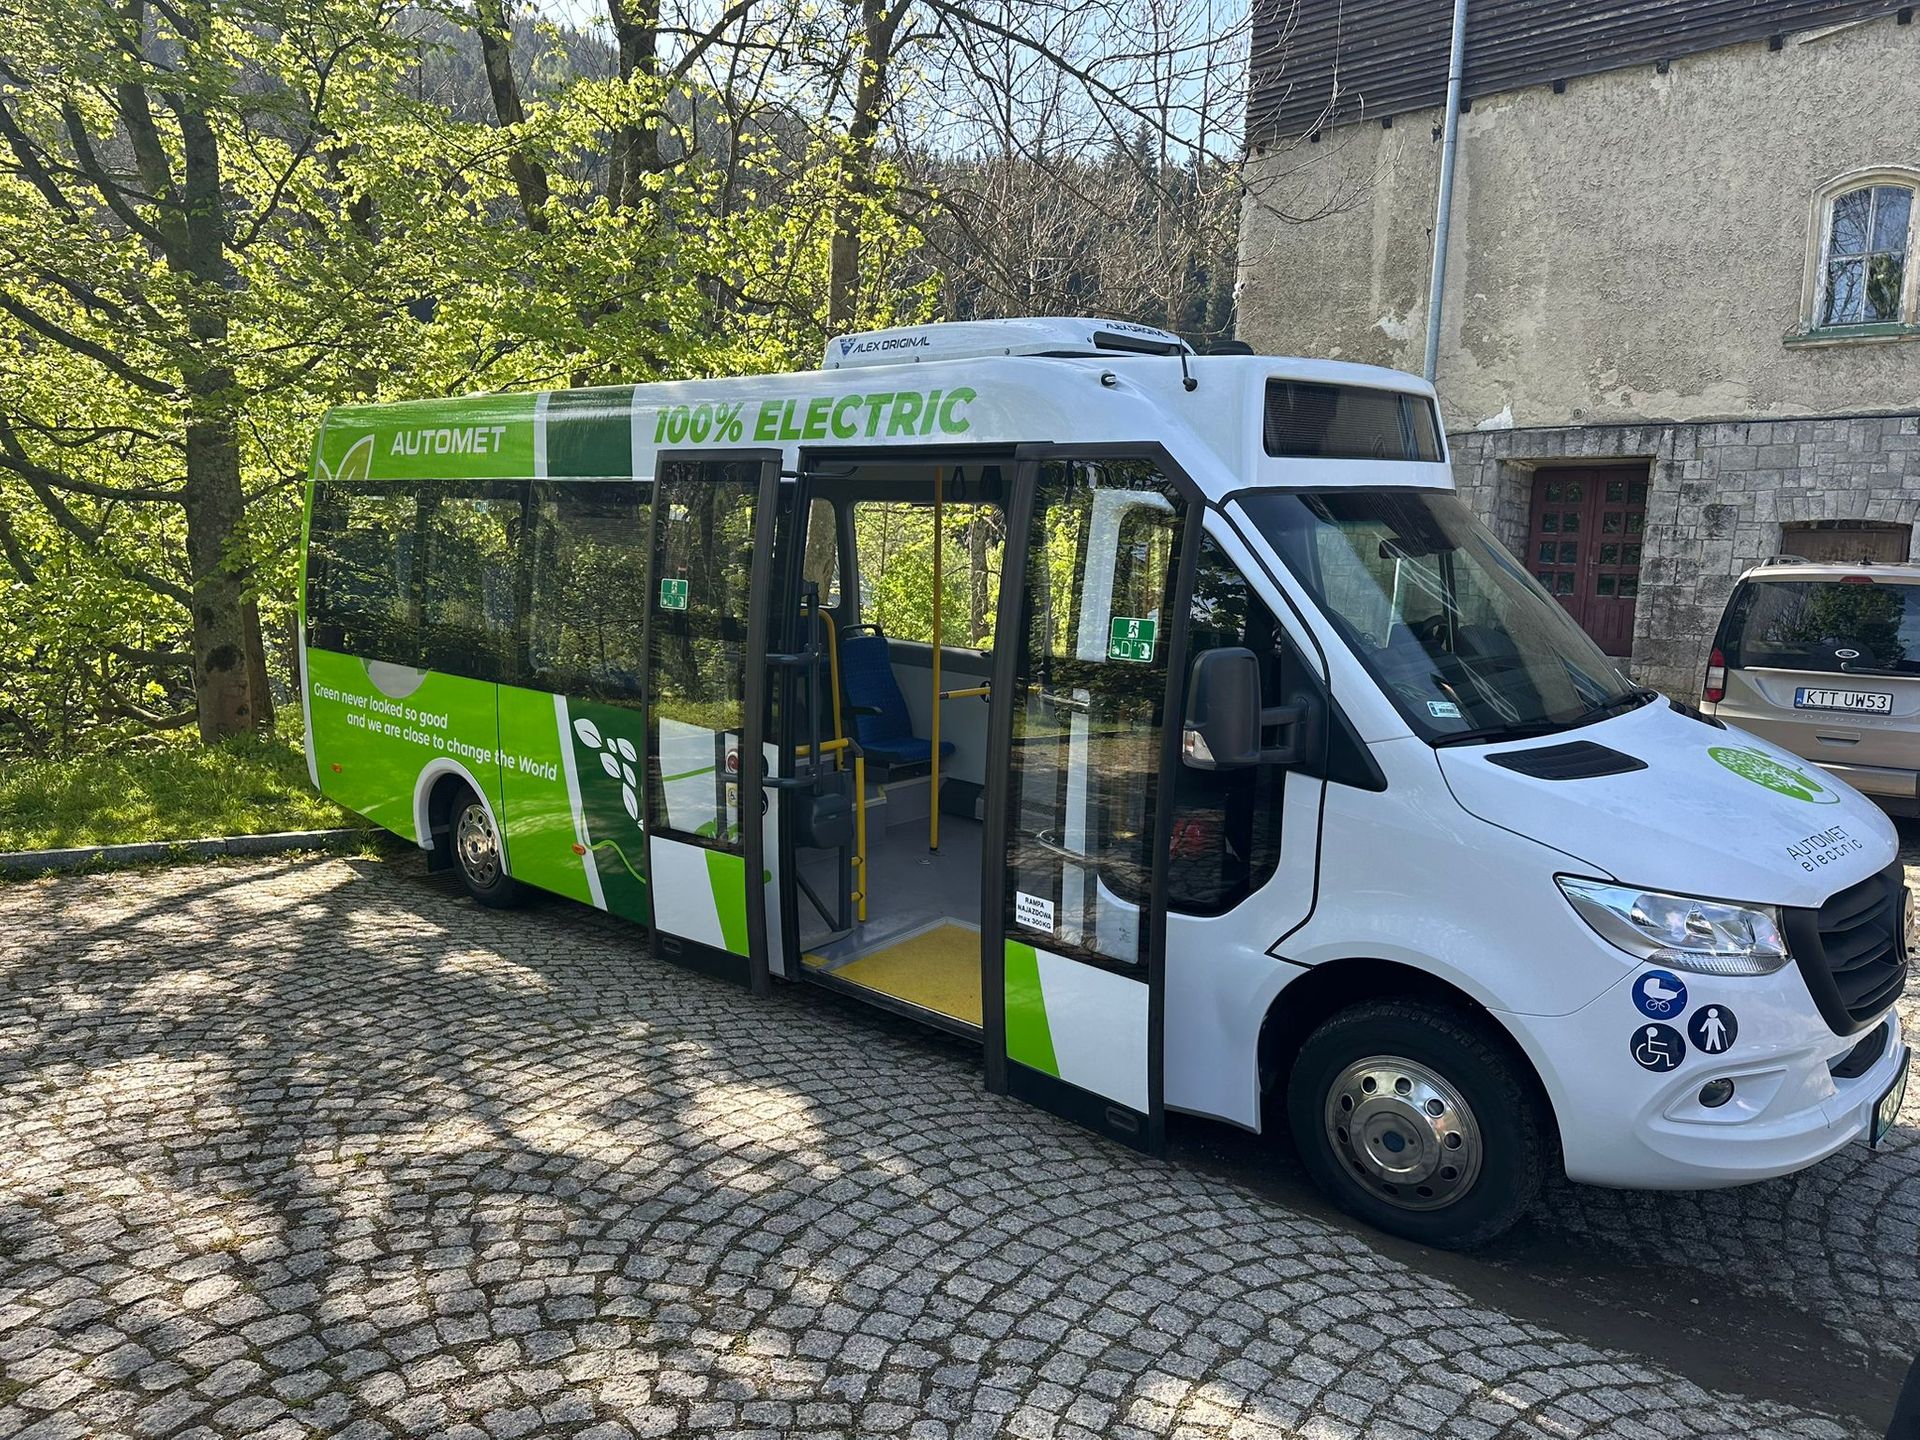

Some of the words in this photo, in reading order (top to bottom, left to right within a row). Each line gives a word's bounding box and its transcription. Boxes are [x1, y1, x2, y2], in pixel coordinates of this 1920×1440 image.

[853, 342, 881, 353] ALEX
[882, 336, 930, 350] ORIGINAL
[653, 400, 745, 444] 100%
[753, 387, 977, 442] ELECTRIC
[391, 426, 506, 456] AUTOMET
[313, 682, 340, 702] Green
[341, 692, 368, 709] never
[369, 696, 403, 719] looked
[405, 707, 418, 722] so
[419, 712, 449, 729] good
[1806, 690, 1838, 706] KTT
[1844, 692, 1887, 709] UW53
[347, 712, 366, 728] and
[367, 719, 383, 732] we
[384, 724, 401, 738] are
[403, 726, 430, 746] close
[432, 734, 444, 749] to
[446, 738, 491, 764] change
[493, 750, 515, 769] the
[518, 755, 557, 781] World
[1786, 825, 1849, 861] AUTOMET
[1801, 839, 1863, 872] electric
[1025, 898, 1044, 908] RAMPA
